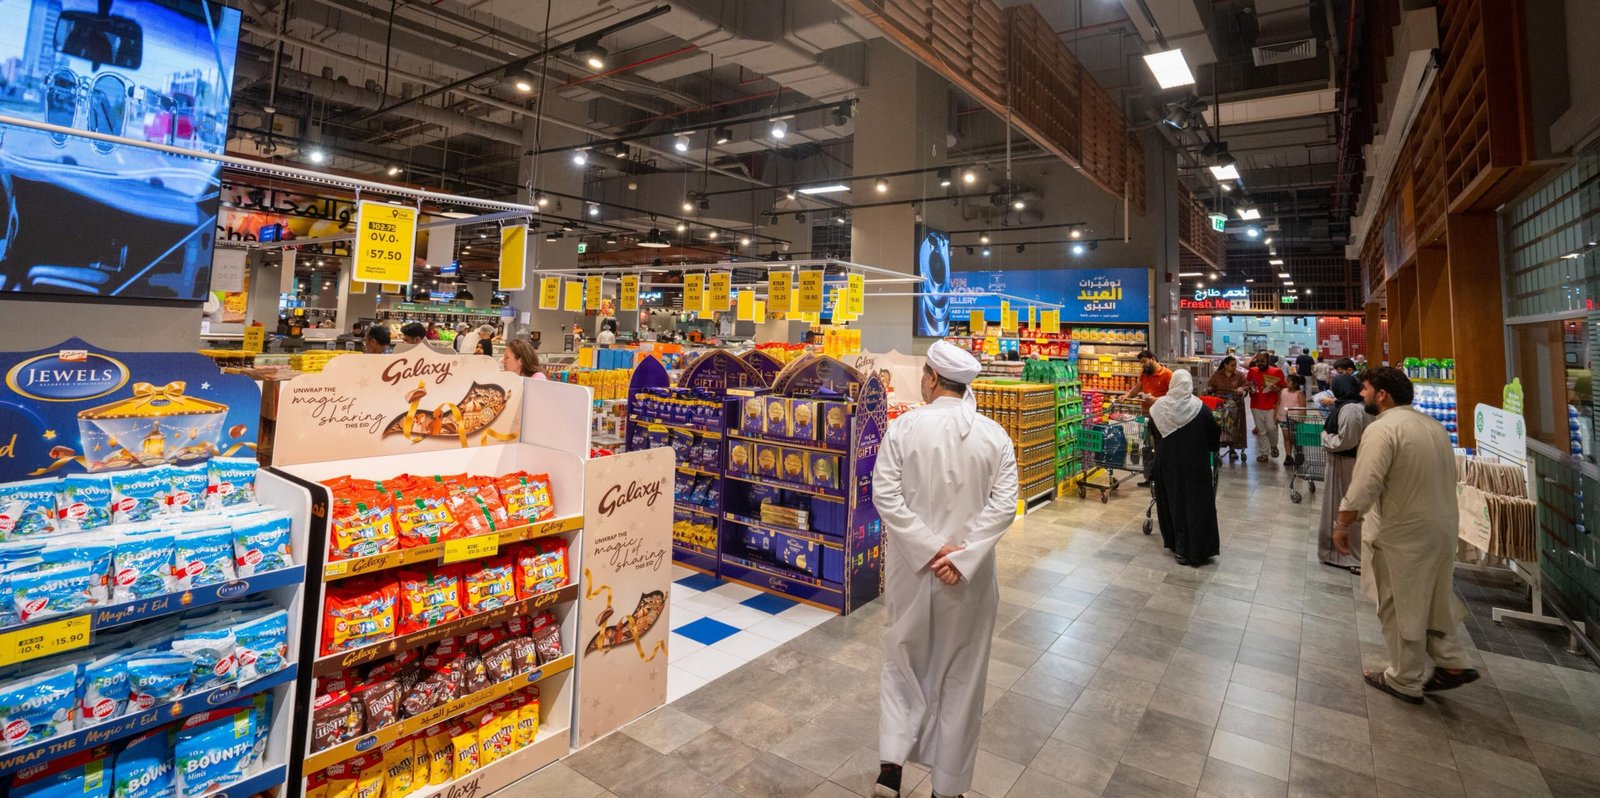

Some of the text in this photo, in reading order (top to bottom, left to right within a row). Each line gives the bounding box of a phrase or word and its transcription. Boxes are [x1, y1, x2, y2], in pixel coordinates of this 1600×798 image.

[371, 249, 401, 260] 57.50
[1077, 288, 1122, 303] العيد
[1180, 300, 1231, 308] Fresh Me
[1084, 302, 1116, 311] الكبرى
[26, 368, 113, 387] JEWELS
[381, 358, 453, 386] Galaxy
[292, 393, 350, 418] magic
[318, 404, 387, 434] sharing
[858, 446, 873, 458] GIFT
[597, 480, 663, 517] Galaxy
[540, 522, 564, 534] Galaxy
[595, 534, 617, 545] UNWRAP
[594, 536, 640, 566] magic
[352, 556, 388, 573] Galaxy
[615, 548, 667, 573] sharing
[635, 563, 646, 571] THIS
[152, 598, 169, 610] Eid
[342, 647, 379, 667] Galaxy
[534, 592, 560, 607] Galaxy
[55, 633, 84, 646] 15.90
[49, 739, 77, 754] THE
[84, 727, 123, 745] Magic
[125, 719, 137, 729] of
[140, 710, 158, 725] Eid
[187, 740, 250, 774] BOUNTY
[128, 757, 174, 793] BOUNT
